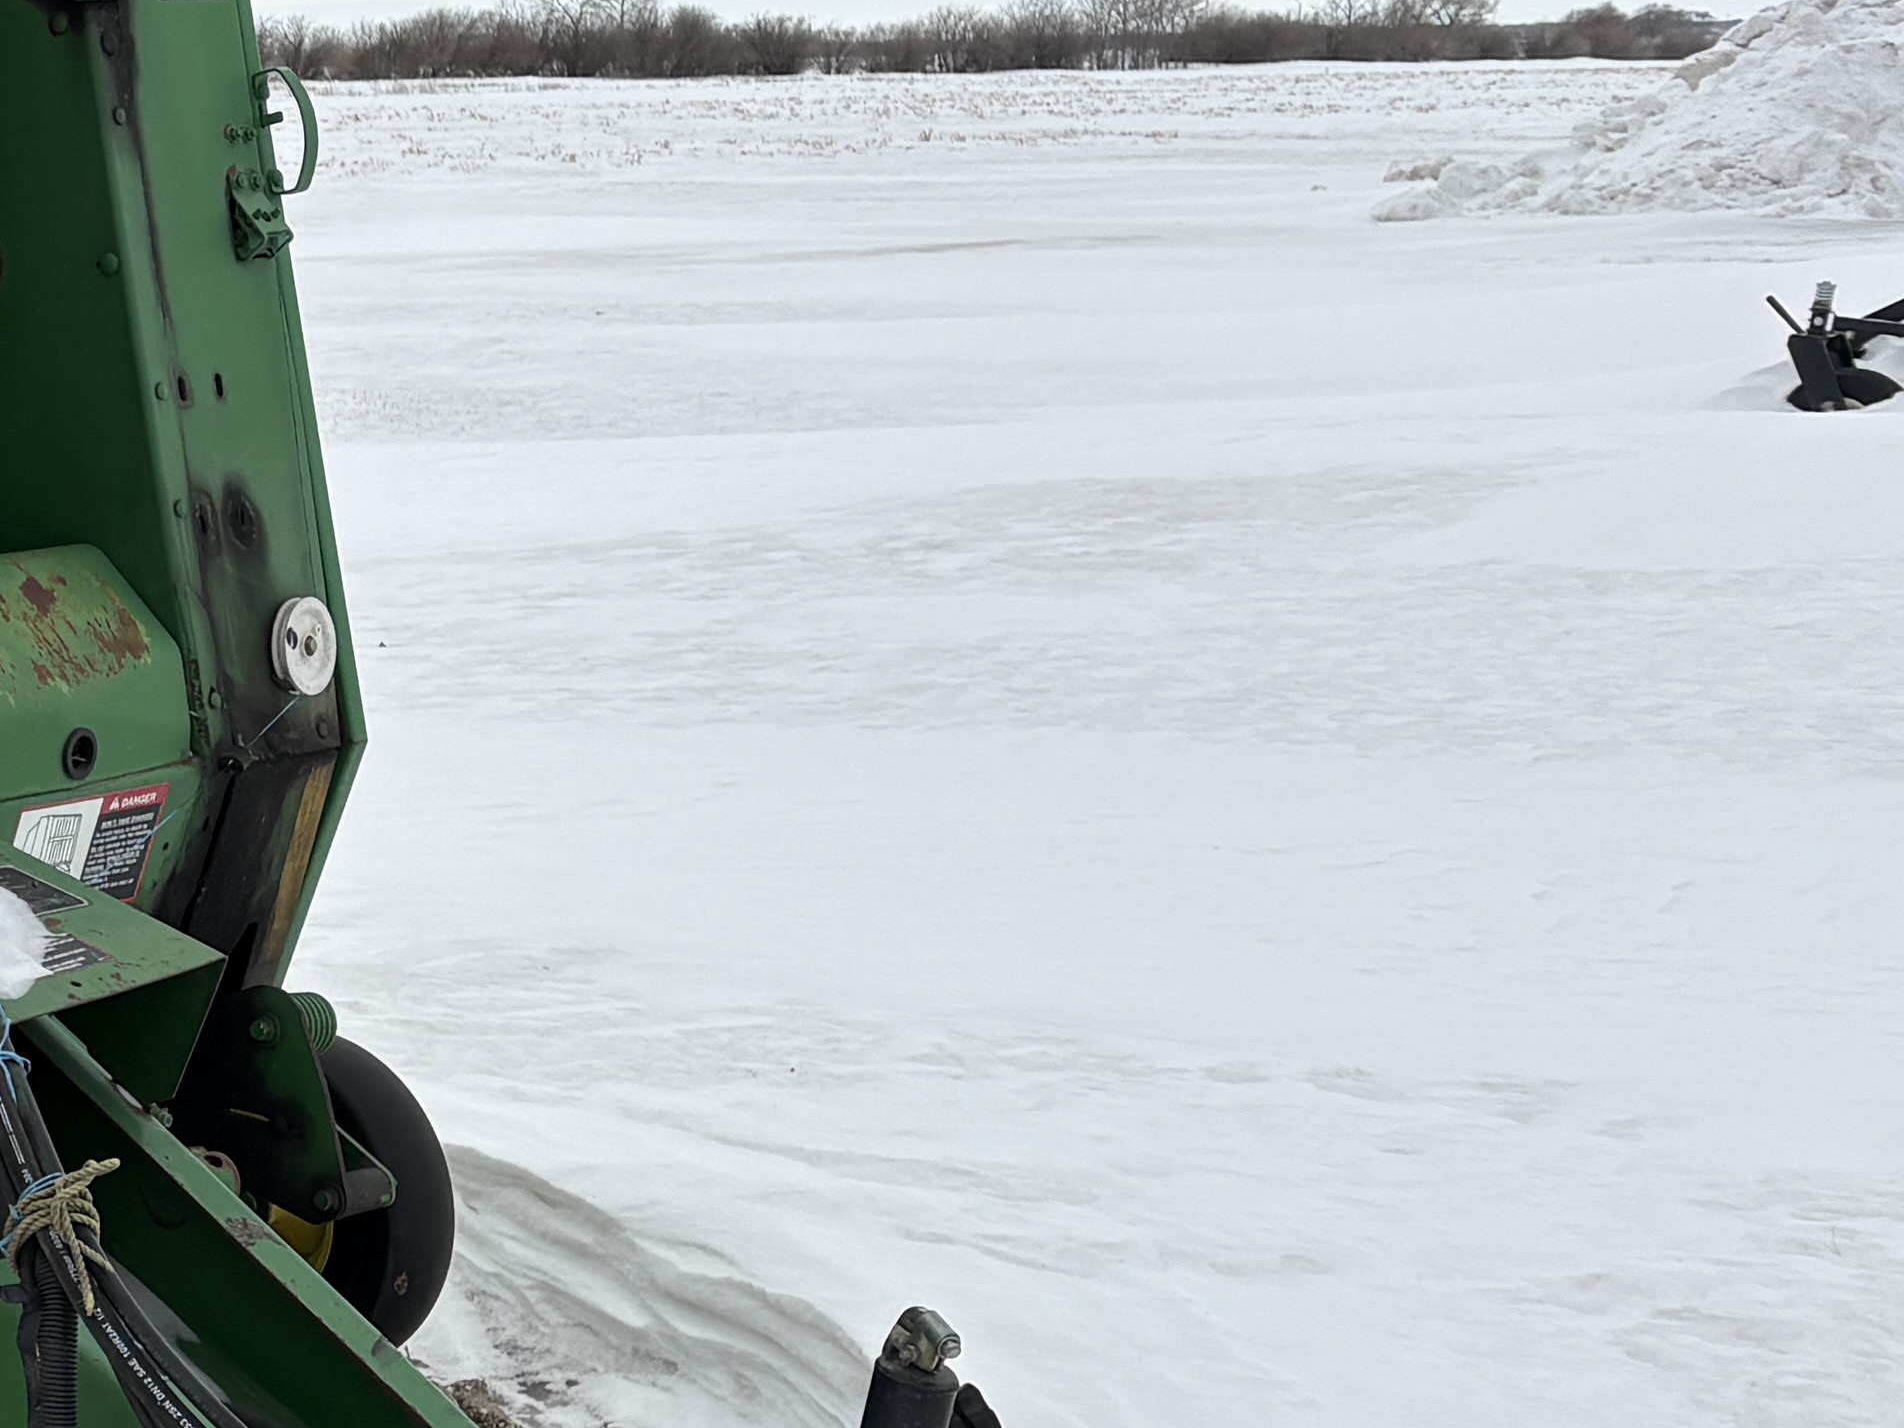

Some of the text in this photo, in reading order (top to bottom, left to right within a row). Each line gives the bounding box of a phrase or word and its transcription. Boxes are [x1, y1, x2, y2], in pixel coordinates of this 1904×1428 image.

[121, 792, 157, 808] DANGER
[99, 1319, 133, 1358] 100R2AT
[126, 1356, 147, 1378] SAE
[141, 1374, 166, 1402] DN12
[160, 1398, 184, 1421] 2SN
